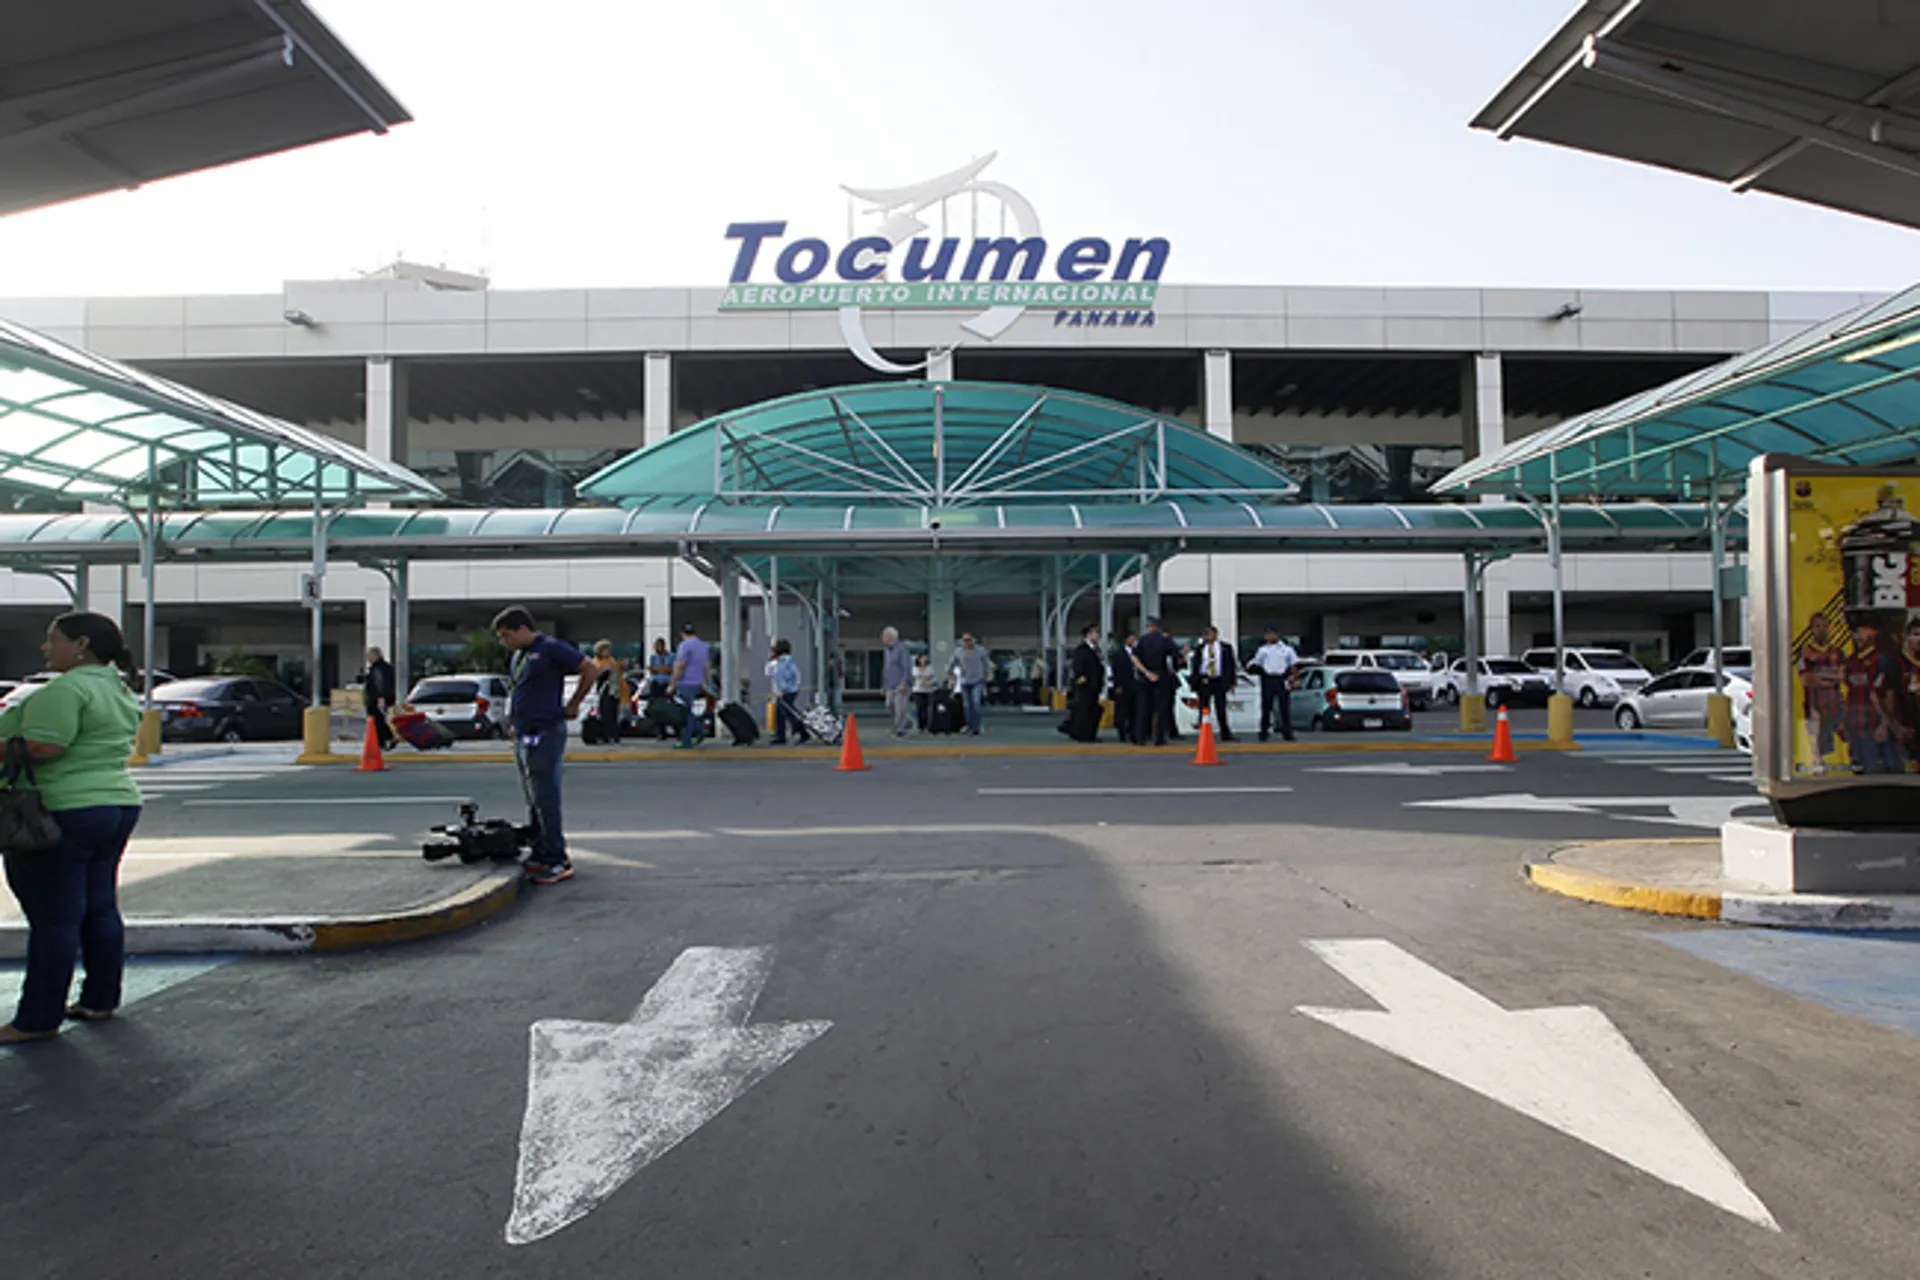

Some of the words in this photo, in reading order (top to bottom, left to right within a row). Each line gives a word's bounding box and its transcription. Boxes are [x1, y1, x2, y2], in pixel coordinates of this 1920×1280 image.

[724, 221, 1171, 283] Tocumen
[723, 285, 911, 304] AEROPUERTO
[926, 284, 1154, 302] INTERNACIONAL
[1053, 310, 1156, 327] PANAMA
